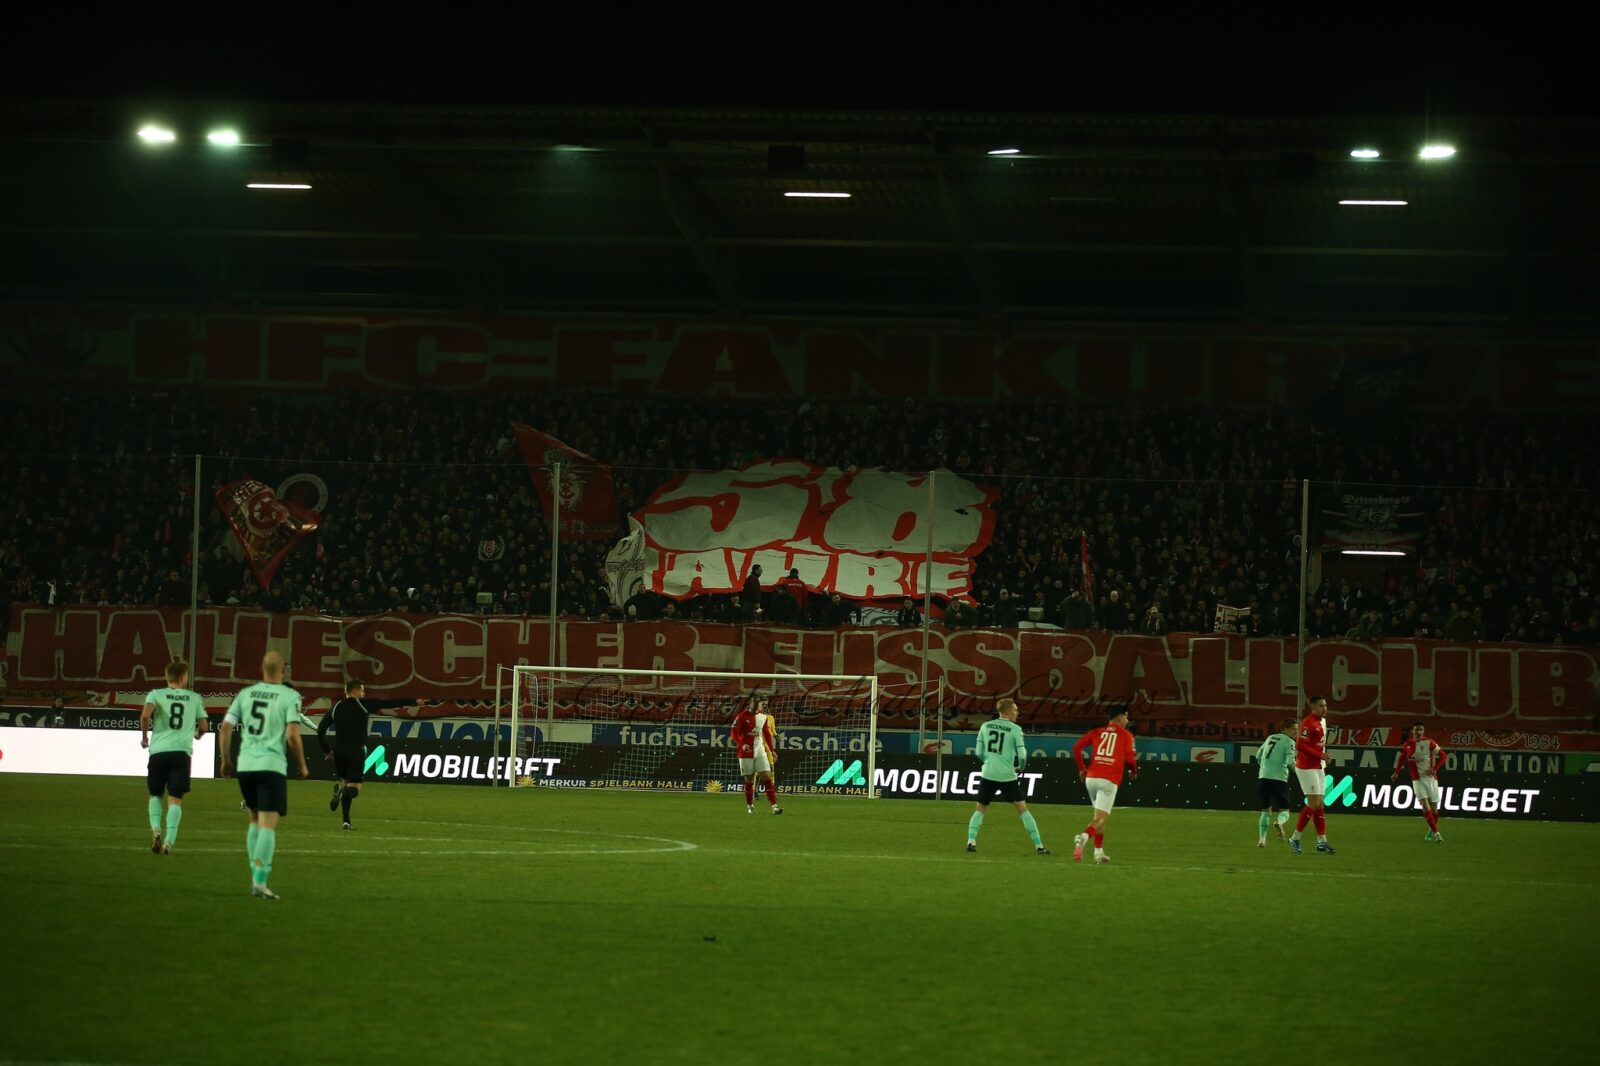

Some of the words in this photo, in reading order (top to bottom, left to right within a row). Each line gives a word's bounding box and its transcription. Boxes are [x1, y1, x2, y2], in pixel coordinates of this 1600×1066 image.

[18, 608, 701, 692] HALLESCHER
[738, 625, 1598, 722] FUSSBALLCLUB
[166, 693, 190, 702] WAGNER
[250, 691, 280, 700] SEEGERT
[169, 702, 184, 730] 8
[248, 700, 268, 735] 5
[988, 730, 1005, 754] 21
[1097, 731, 1118, 757] 20
[1266, 740, 1277, 759] 7
[1523, 733, 1560, 750] 1984
[539, 778, 587, 788] MERKUR
[589, 779, 654, 789] SPIELBANK
[656, 780, 694, 789] HALLE
[777, 785, 842, 795] SPIELBANK
[873, 768, 1043, 797] MOBILET
